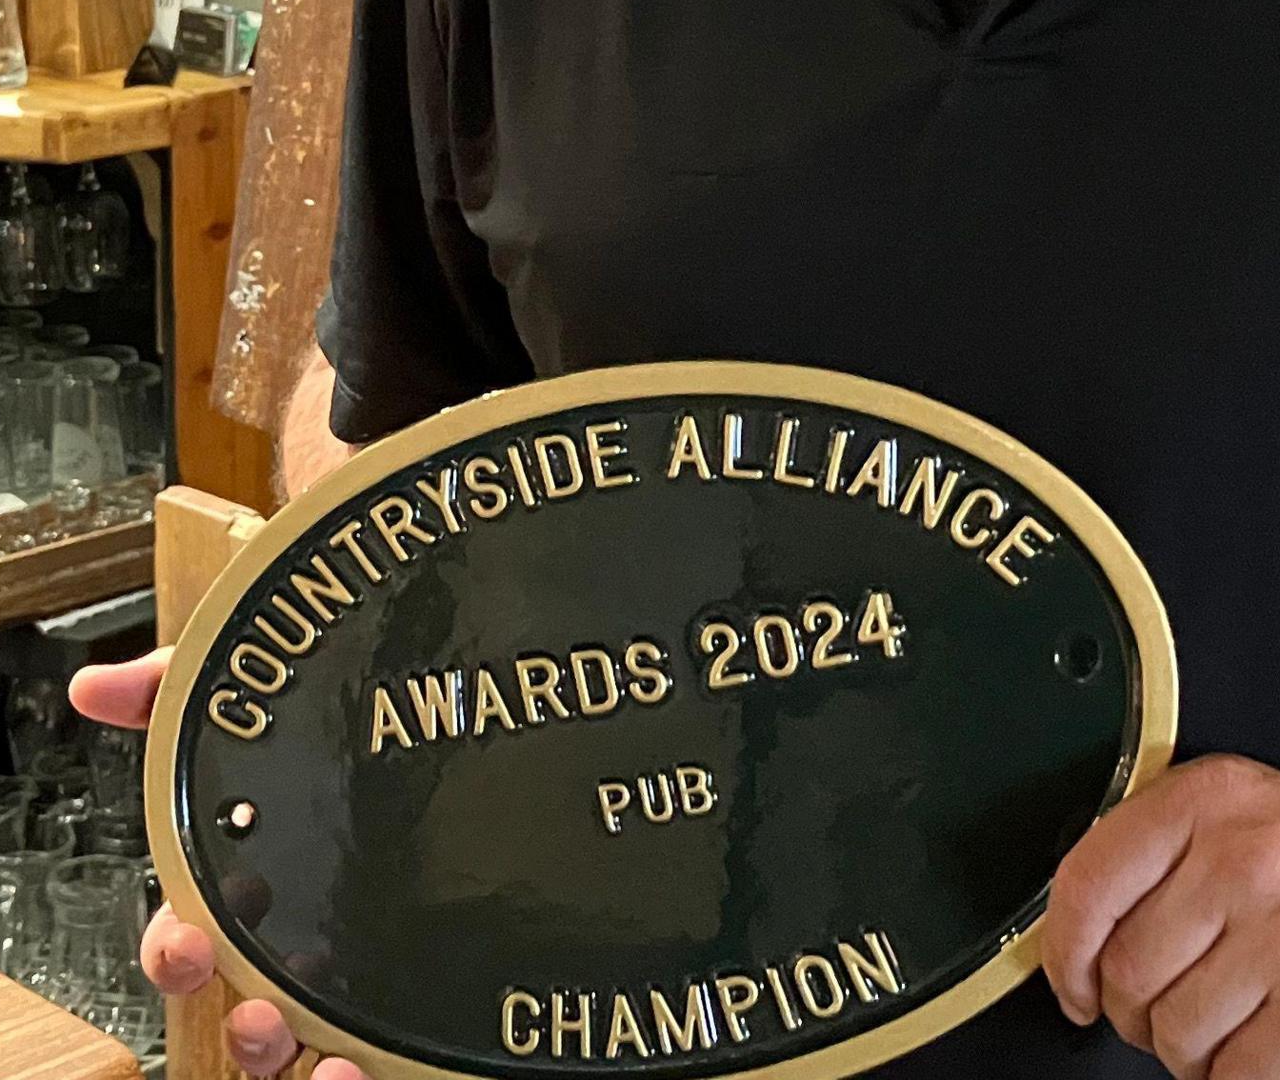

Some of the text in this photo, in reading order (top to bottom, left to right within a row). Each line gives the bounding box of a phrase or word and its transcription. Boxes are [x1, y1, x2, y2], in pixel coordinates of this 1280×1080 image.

[206, 409, 1058, 742] COUNTRYSIDE ALLIANCE
[366, 588, 908, 754] AWARDS 2024
[596, 765, 718, 834] PUB
[499, 929, 910, 1062] CHAMPION
